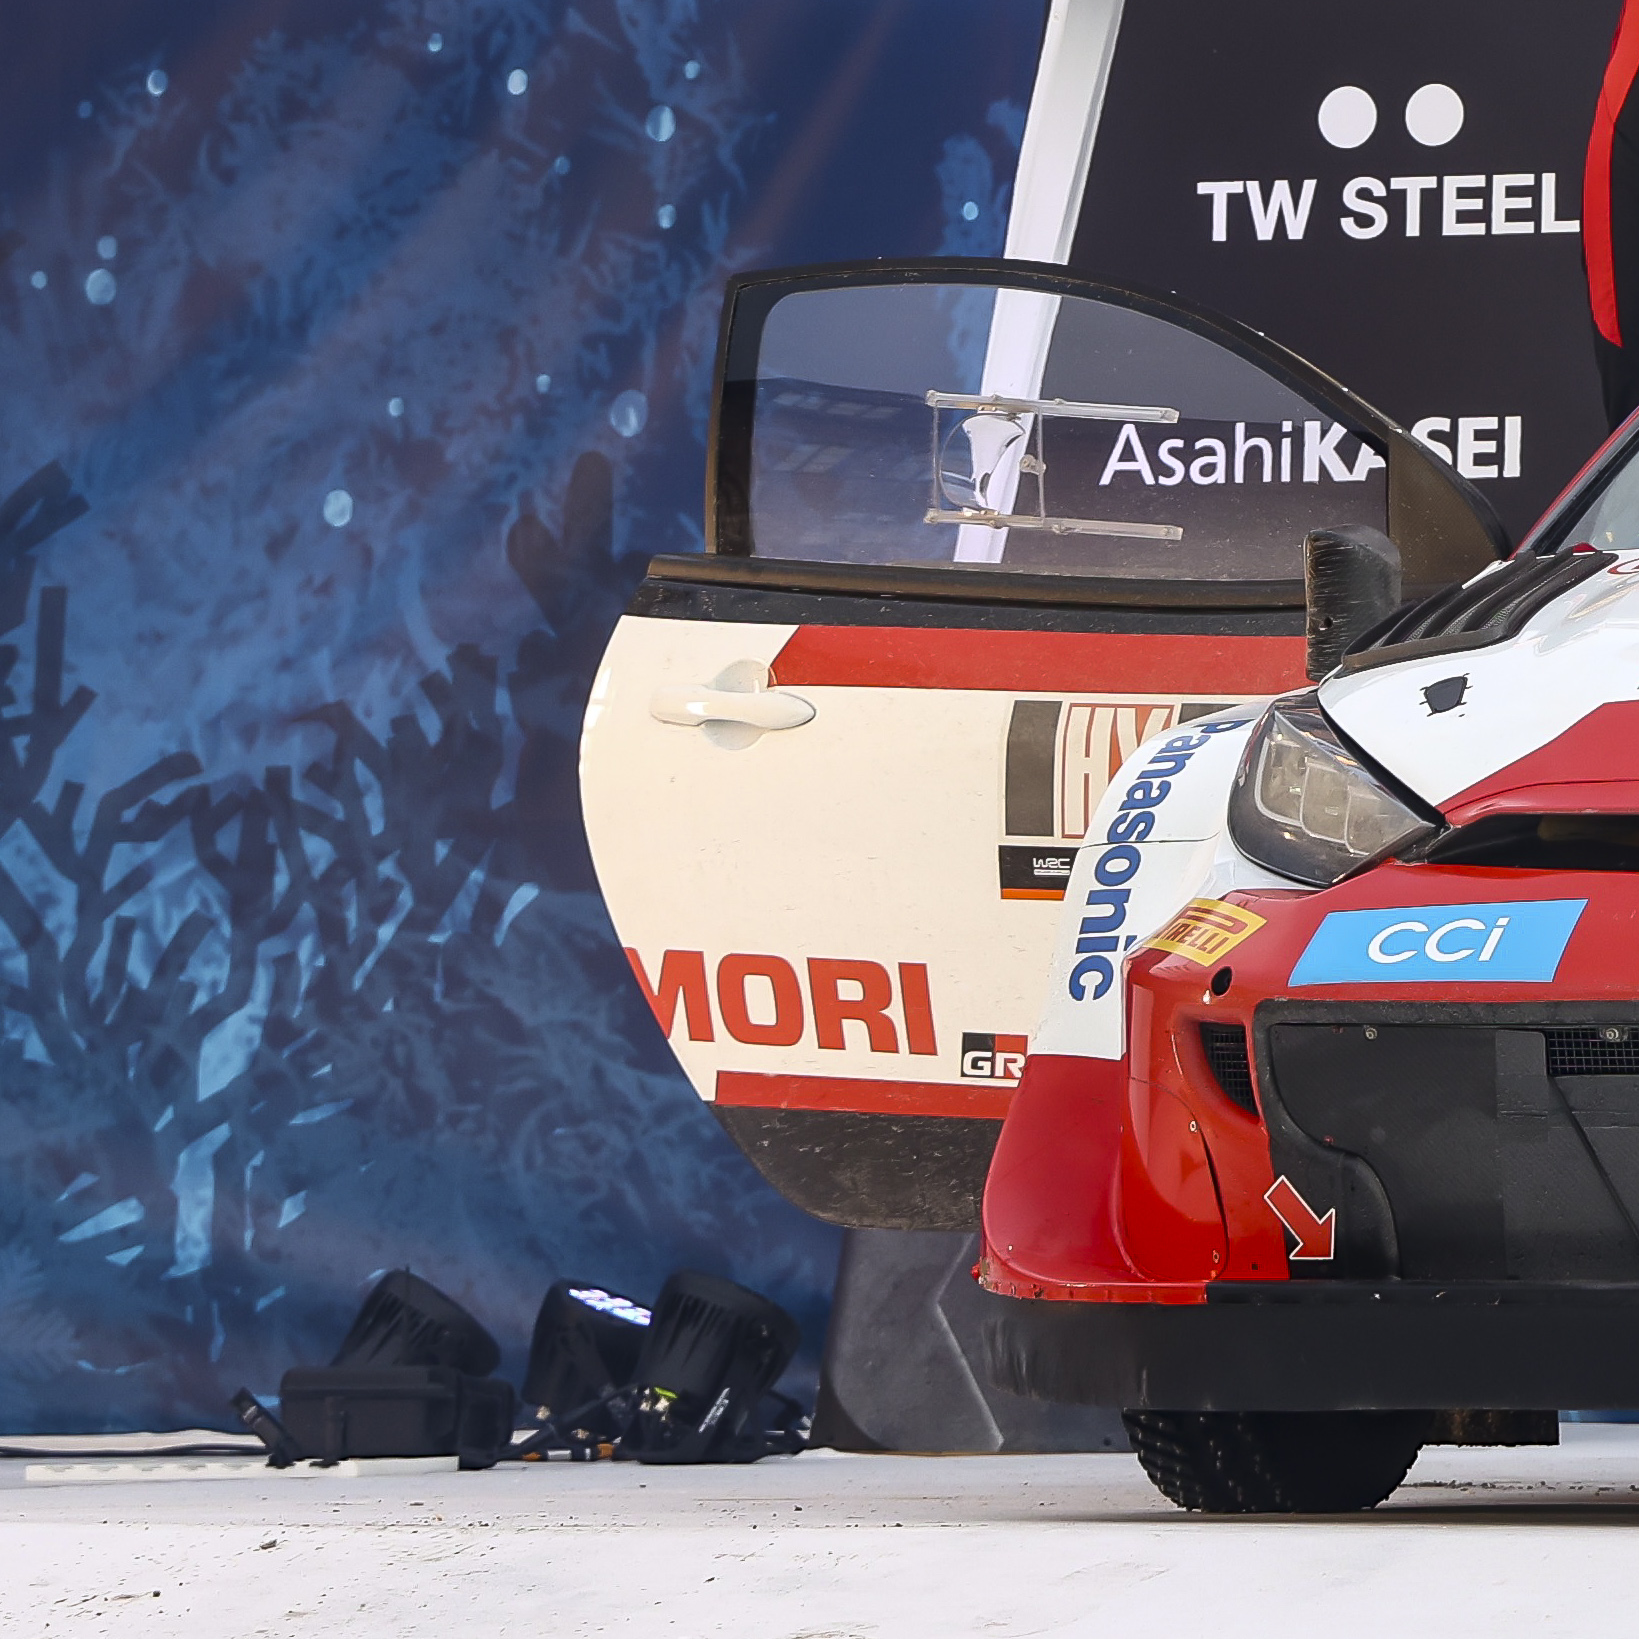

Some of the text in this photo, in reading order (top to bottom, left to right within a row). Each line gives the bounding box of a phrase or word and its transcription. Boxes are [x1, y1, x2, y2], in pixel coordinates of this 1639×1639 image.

[1196, 172, 1581, 242] TW STEEL
[1032, 856, 1071, 869] WRC
[1068, 718, 1258, 1002] Panasonic
[1367, 916, 1512, 964] CCi
[623, 948, 938, 1056] MORI
[961, 1050, 1027, 1078] GR
